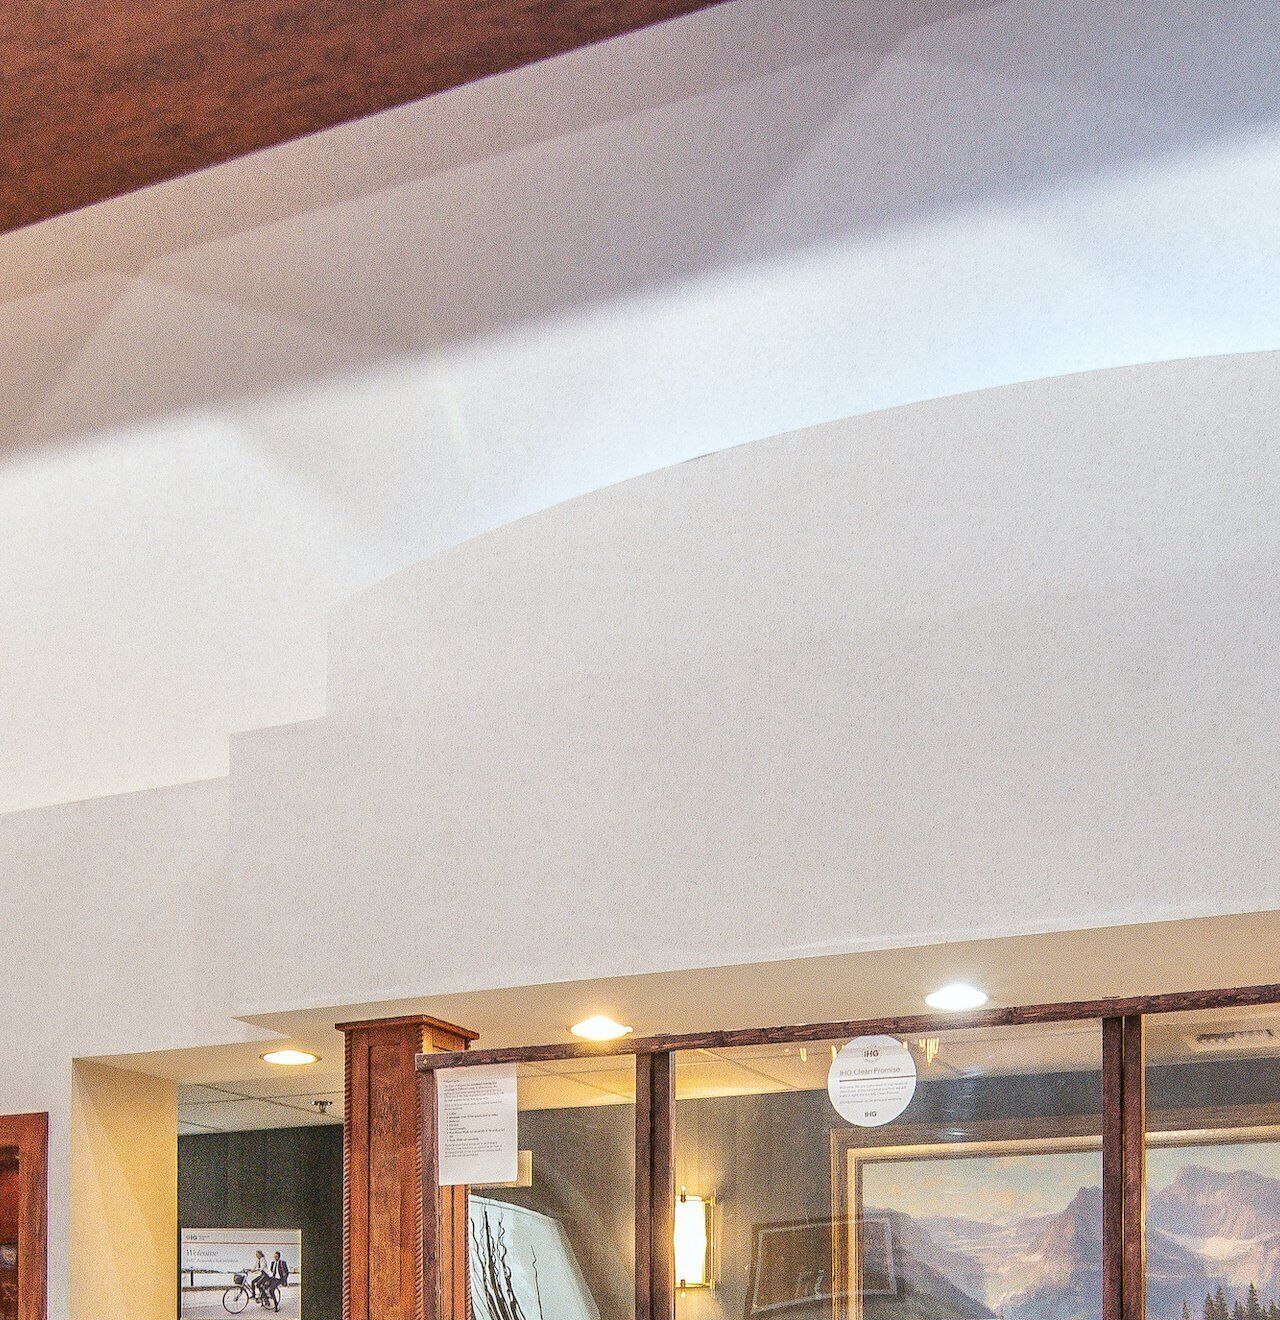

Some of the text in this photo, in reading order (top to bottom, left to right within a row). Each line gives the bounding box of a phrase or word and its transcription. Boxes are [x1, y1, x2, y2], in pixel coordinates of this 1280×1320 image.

[863, 1049, 879, 1058] IHG
[853, 1068, 873, 1076] Clean
[873, 1067, 901, 1075] Promise
